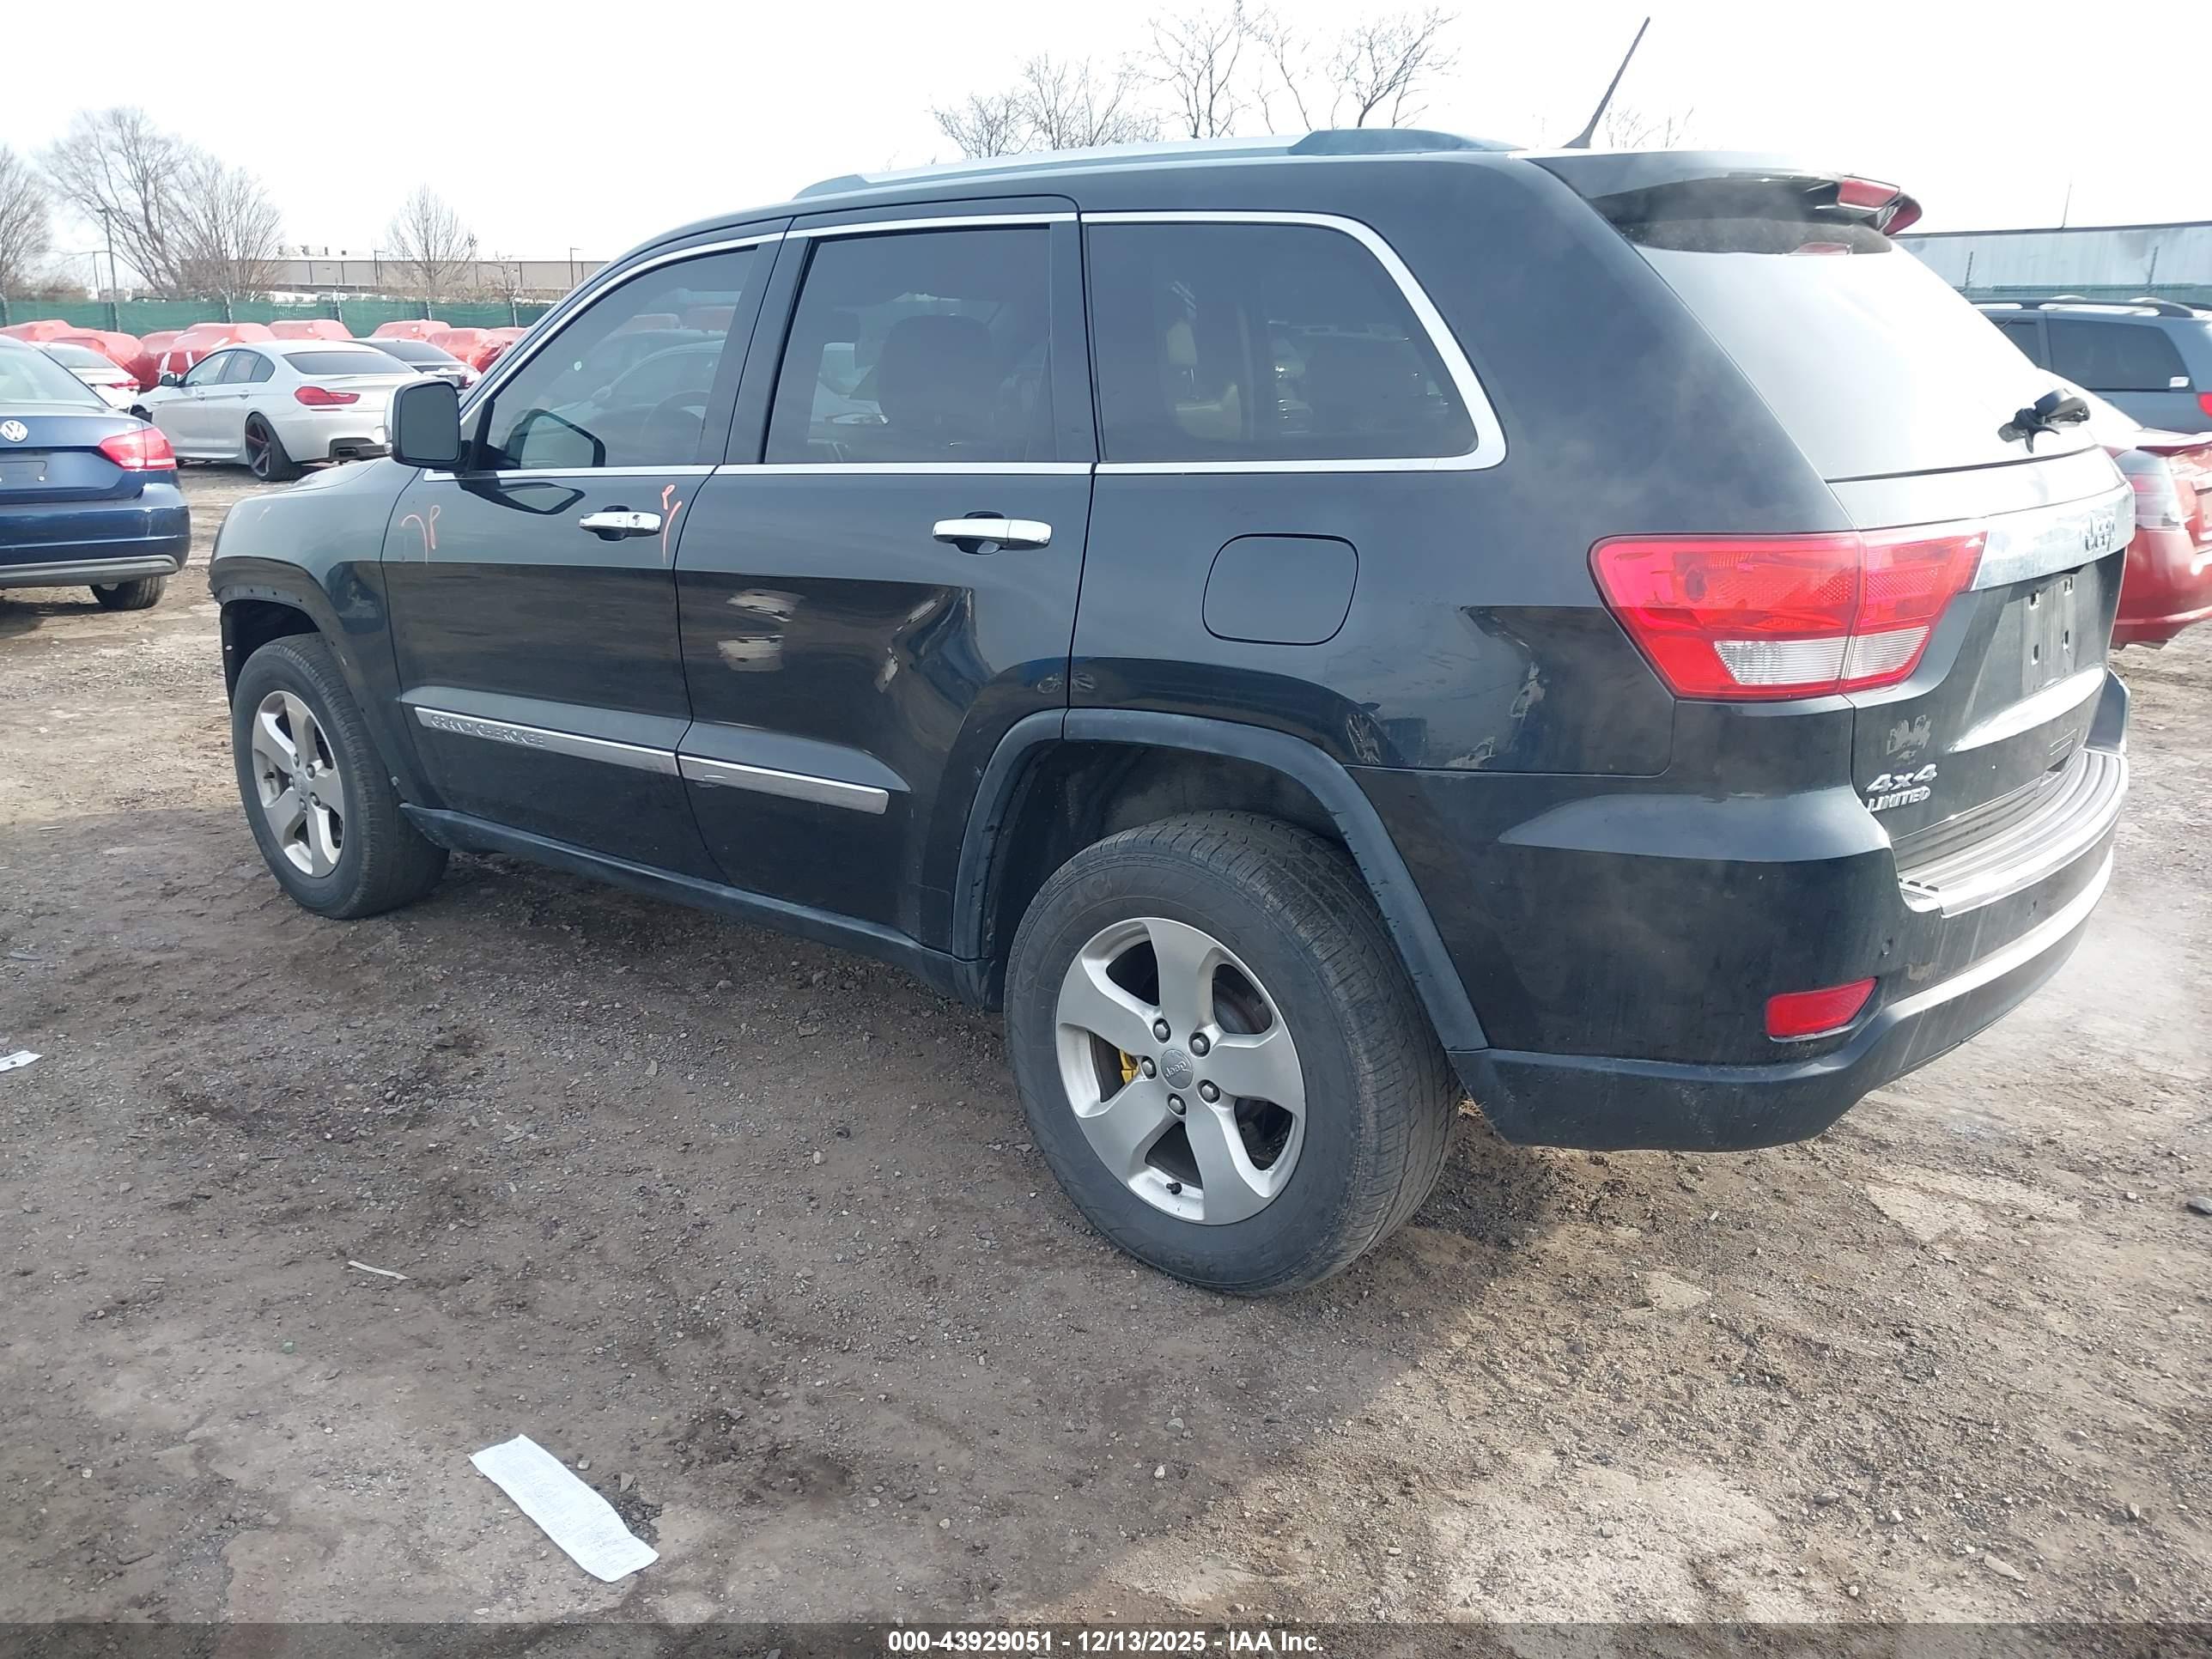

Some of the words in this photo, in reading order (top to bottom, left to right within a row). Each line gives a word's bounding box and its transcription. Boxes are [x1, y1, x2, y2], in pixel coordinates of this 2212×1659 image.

[430, 714, 471, 736] GRAND
[474, 723, 546, 748] CHEROKEE
[1865, 763, 1938, 793] 4x4
[1867, 785, 1931, 812] LIMITED
